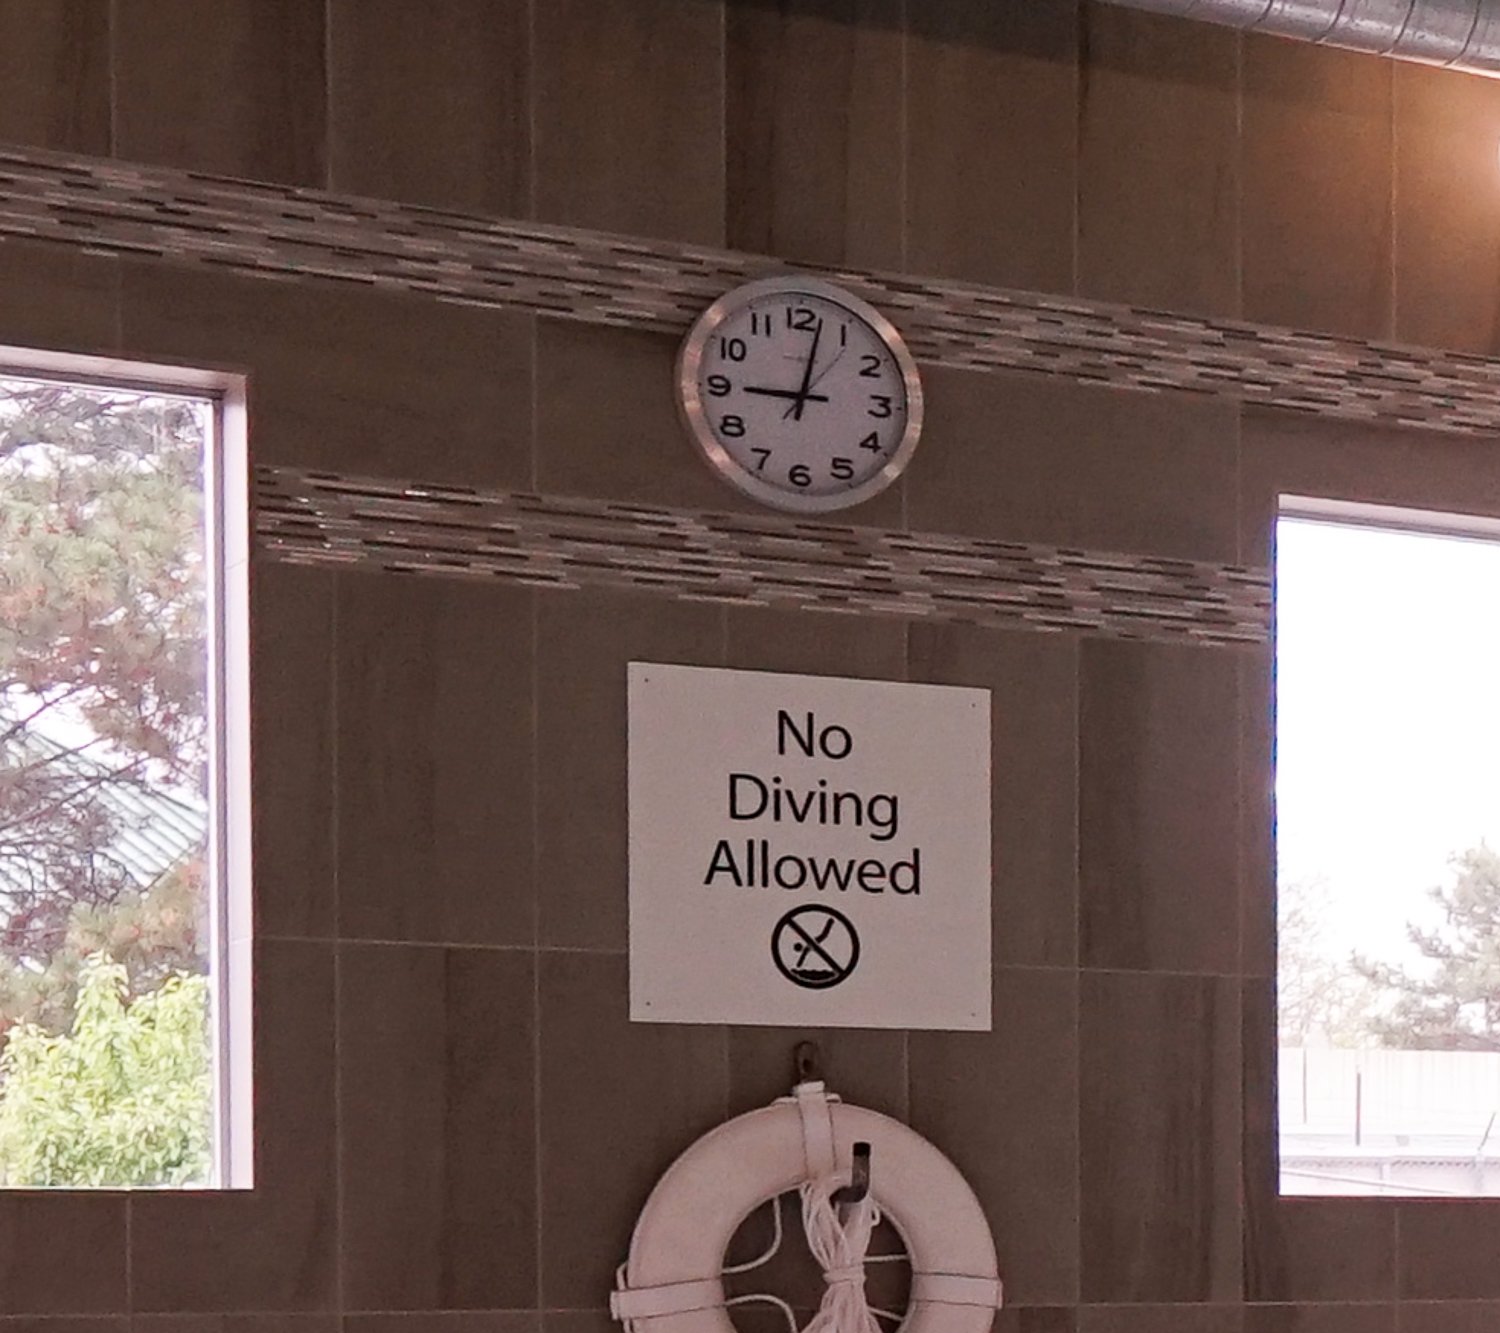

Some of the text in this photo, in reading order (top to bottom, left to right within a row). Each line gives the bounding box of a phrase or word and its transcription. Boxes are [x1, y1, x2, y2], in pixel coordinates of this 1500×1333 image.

[752, 312, 771, 337] 11
[787, 306, 816, 332] 12
[841, 324, 846, 347] 1
[720, 337, 747, 362] 10
[859, 355, 881, 378] 2
[707, 375, 731, 397] 9
[868, 395, 892, 418] 3
[719, 415, 746, 438] 8
[859, 431, 882, 453] 4
[751, 448, 772, 470] 7
[830, 457, 854, 480] 5
[788, 465, 812, 487] 6
[778, 709, 853, 760] No
[729, 773, 898, 841] Diving
[703, 839, 921, 896] Allowed
